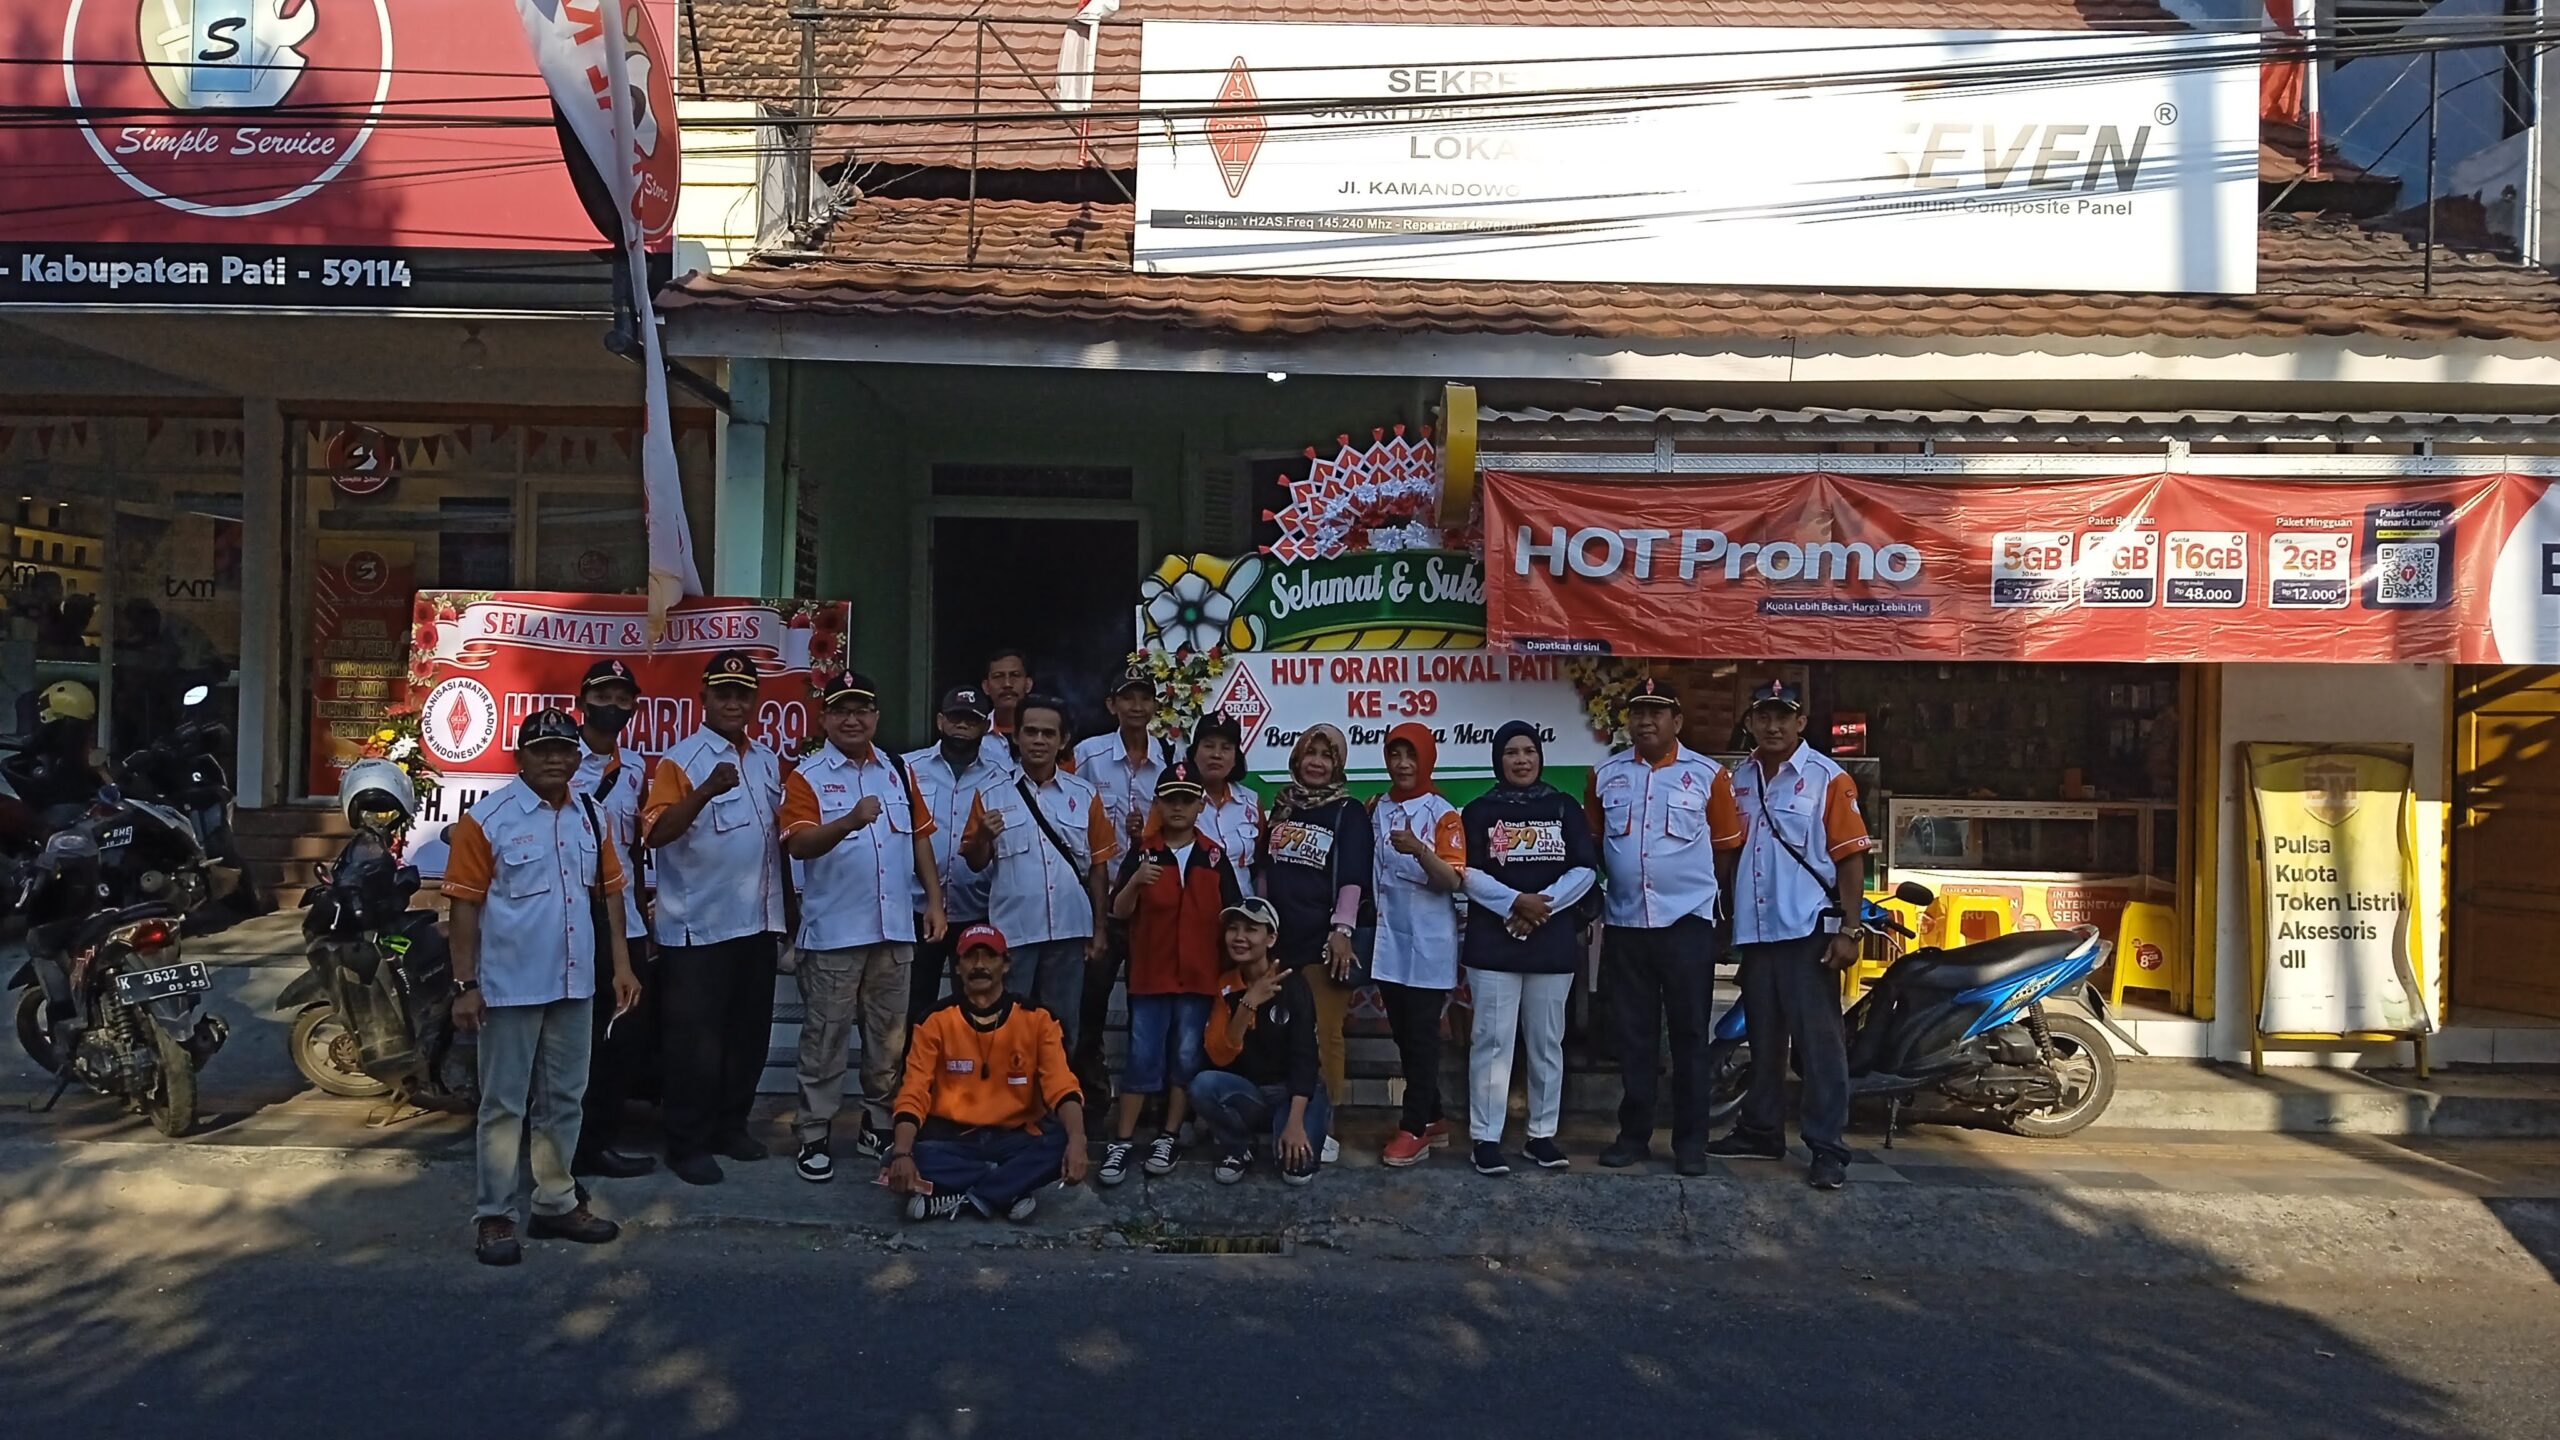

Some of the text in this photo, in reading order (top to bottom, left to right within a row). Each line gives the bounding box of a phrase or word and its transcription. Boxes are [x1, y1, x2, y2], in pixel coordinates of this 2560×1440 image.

[116, 127, 335, 160] Simple Service
[1963, 198, 2070, 216] Composite
[2077, 200, 2132, 216] Panel
[1184, 214, 1237, 228] Callsign:
[1318, 217, 1364, 228] 145.240
[1367, 218, 1392, 229] Mhz
[1403, 219, 1459, 233] Repeater
[22, 253, 209, 289] Kabupaten
[221, 255, 286, 286] Pati
[321, 258, 411, 288] 59114
[2088, 517, 2155, 526] Paket Bnan
[2380, 509, 2441, 518] Paket Internet
[2276, 518, 2352, 530] Paket Mingguan
[2375, 518, 2445, 529] Menarik Lainnya
[1514, 525, 1922, 582] HOT Promo
[2003, 542, 2063, 571] 5GB
[2170, 543, 2243, 570] 16GB
[2283, 545, 2337, 571] 2GB
[1270, 563, 1385, 620] Selamat
[1388, 560, 1413, 604] &
[2014, 588, 2059, 600] 27.000
[2103, 587, 2144, 600] 35.000
[2175, 587, 2232, 600] Rp 48.000
[2282, 589, 2292, 598] Rp
[1766, 602, 1922, 614] Kuota Lebih Besar, Harga Lebih Irit
[484, 611, 760, 647] SELAMAT & UKSES
[1527, 641, 1600, 653] Dapatkan di sini
[1271, 654, 1558, 685] HUT ORARI LOKAL PATI
[458, 681, 489, 703] AMATIR
[424, 681, 456, 734] ORGANISASI
[1224, 702, 1260, 714] ORARI
[485, 703, 495, 736] RADIO
[432, 741, 483, 760] INDONESIA
[2274, 836, 2331, 854] Pulsa
[2276, 864, 2338, 882] Kuota
[2068, 891, 2092, 899] BARU
[2276, 891, 2407, 912] Token Listrik
[1962, 911, 1984, 920] ERU
[2053, 911, 2091, 923] SERU
[2278, 920, 2377, 940] Aksesoris
[2279, 950, 2306, 969] dll
[120, 976, 131, 990] K
[142, 968, 180, 985] 3632
